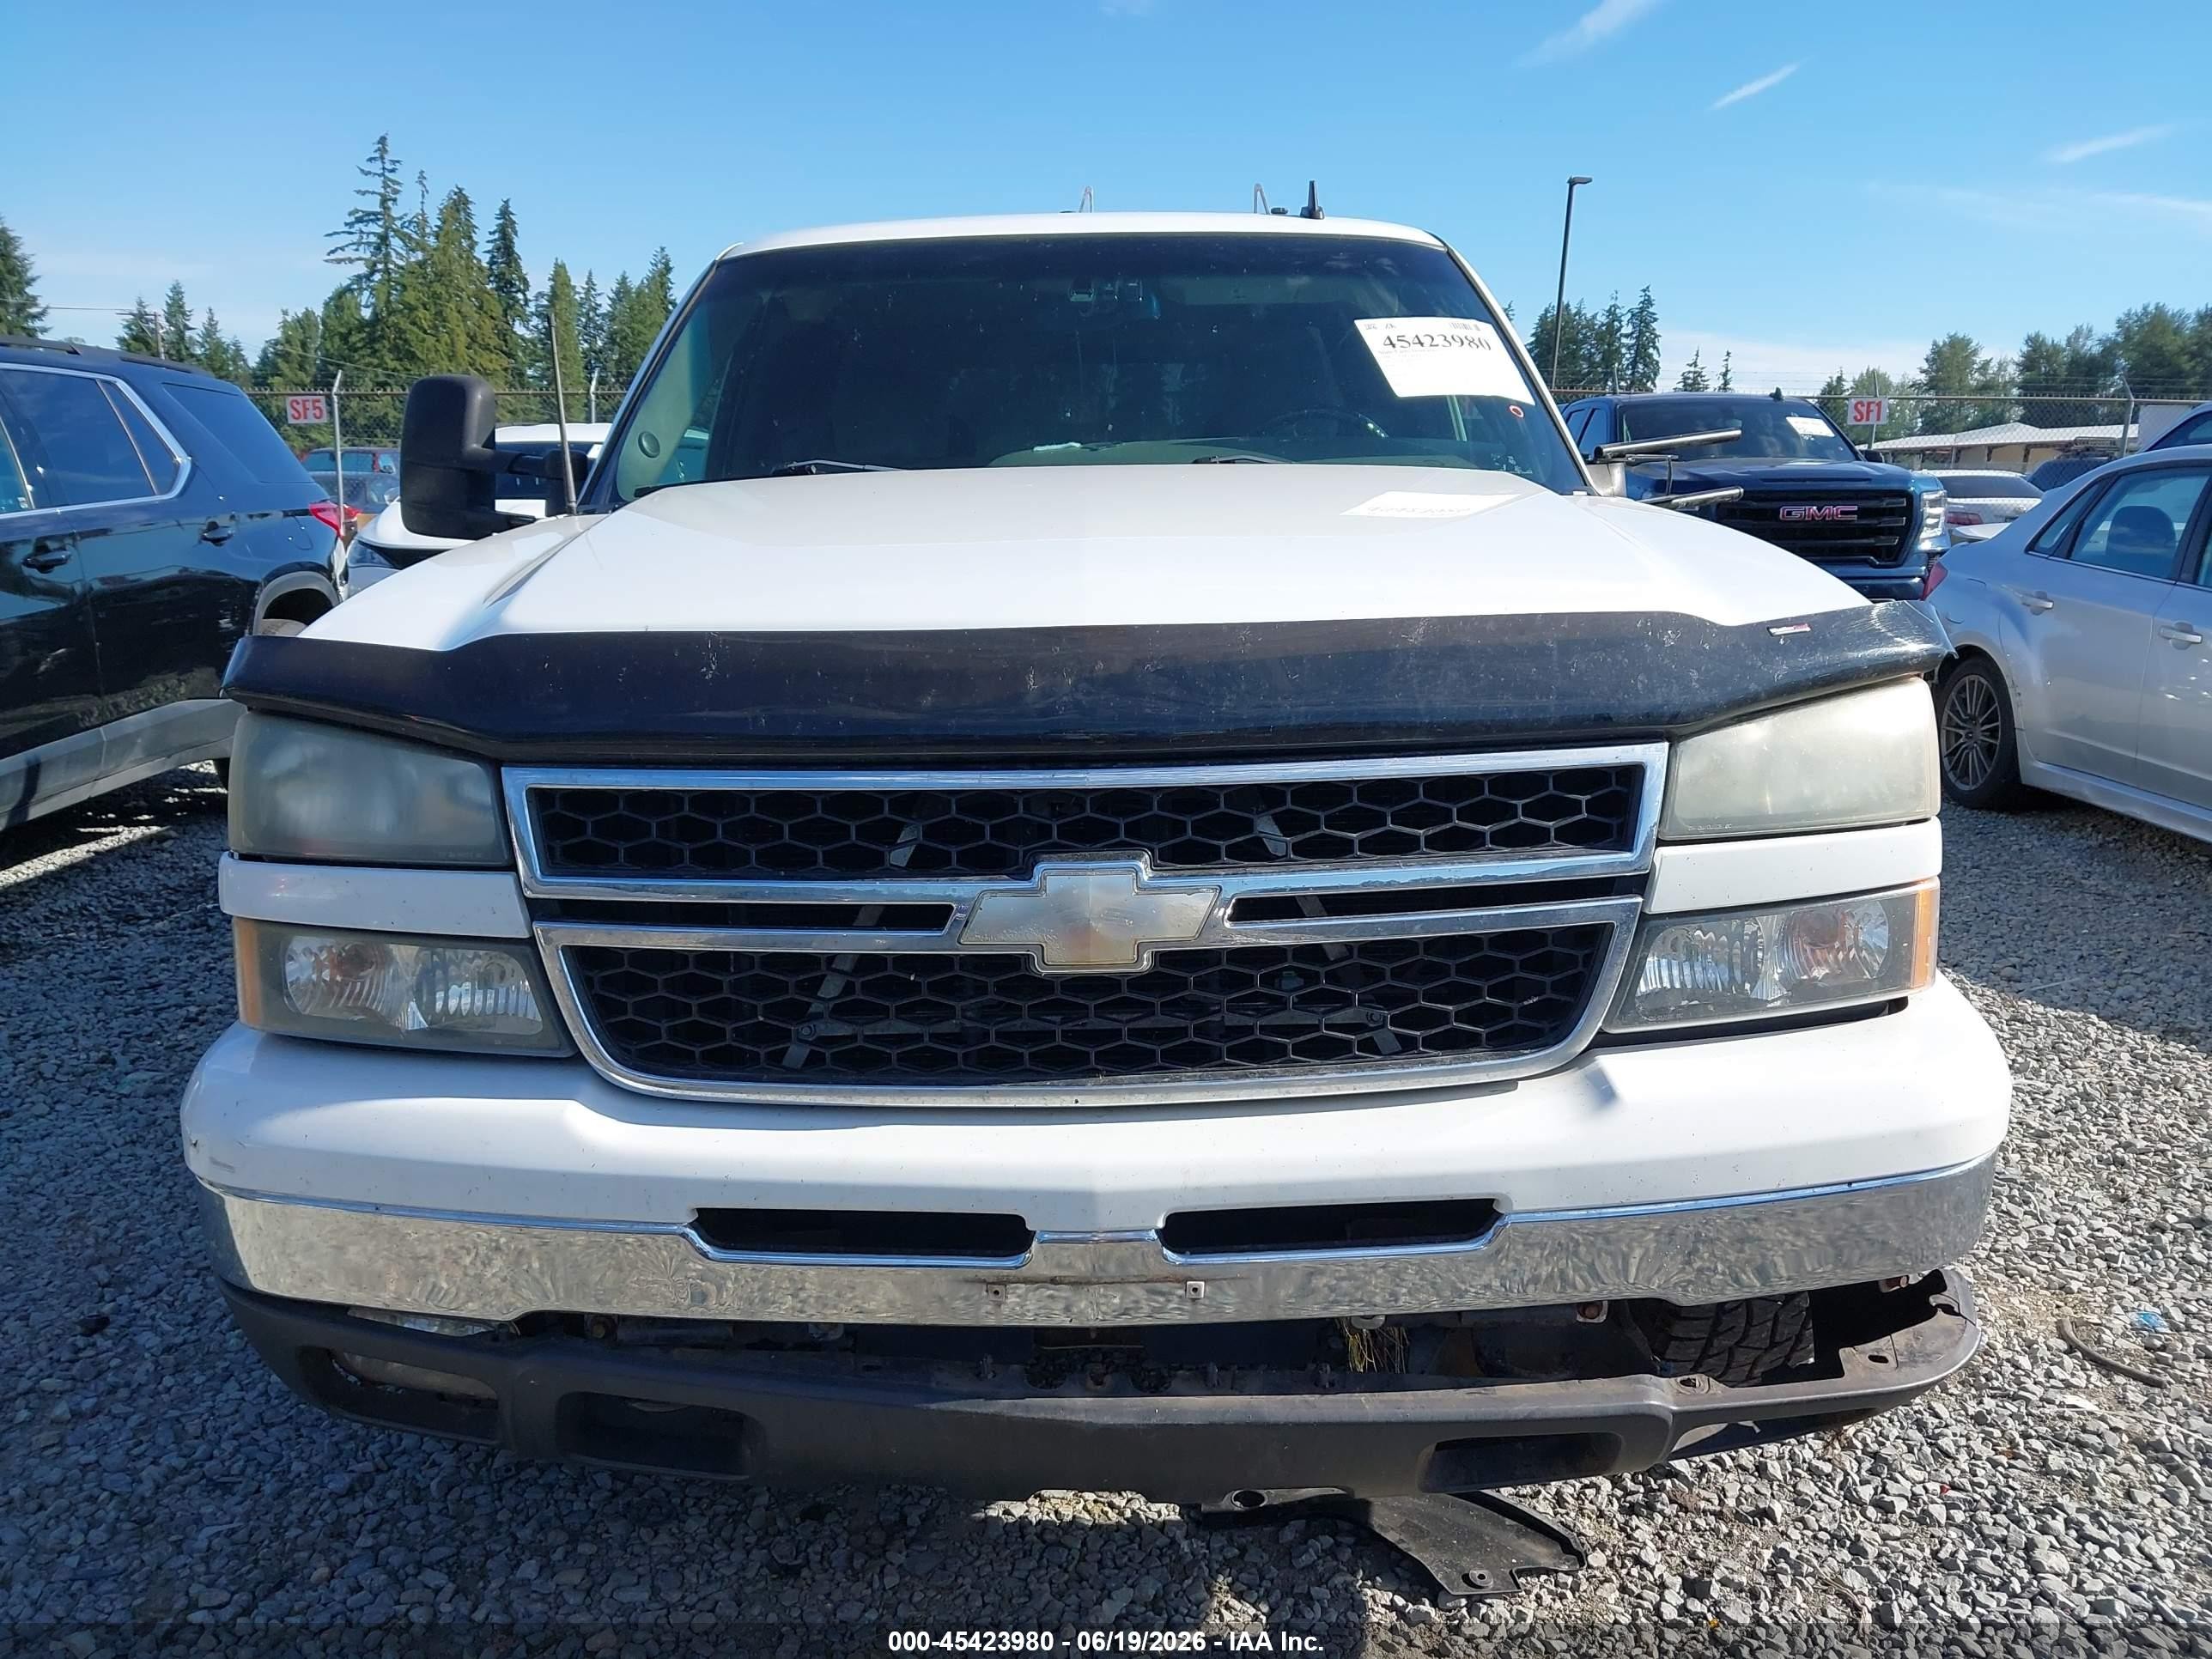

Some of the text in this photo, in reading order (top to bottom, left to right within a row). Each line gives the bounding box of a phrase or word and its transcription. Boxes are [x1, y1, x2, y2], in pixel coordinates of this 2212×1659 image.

[1382, 333, 1492, 350] 45423980
[289, 398, 324, 420] SF5
[1853, 400, 1882, 422] SF1
[1779, 505, 1858, 520] GMC
